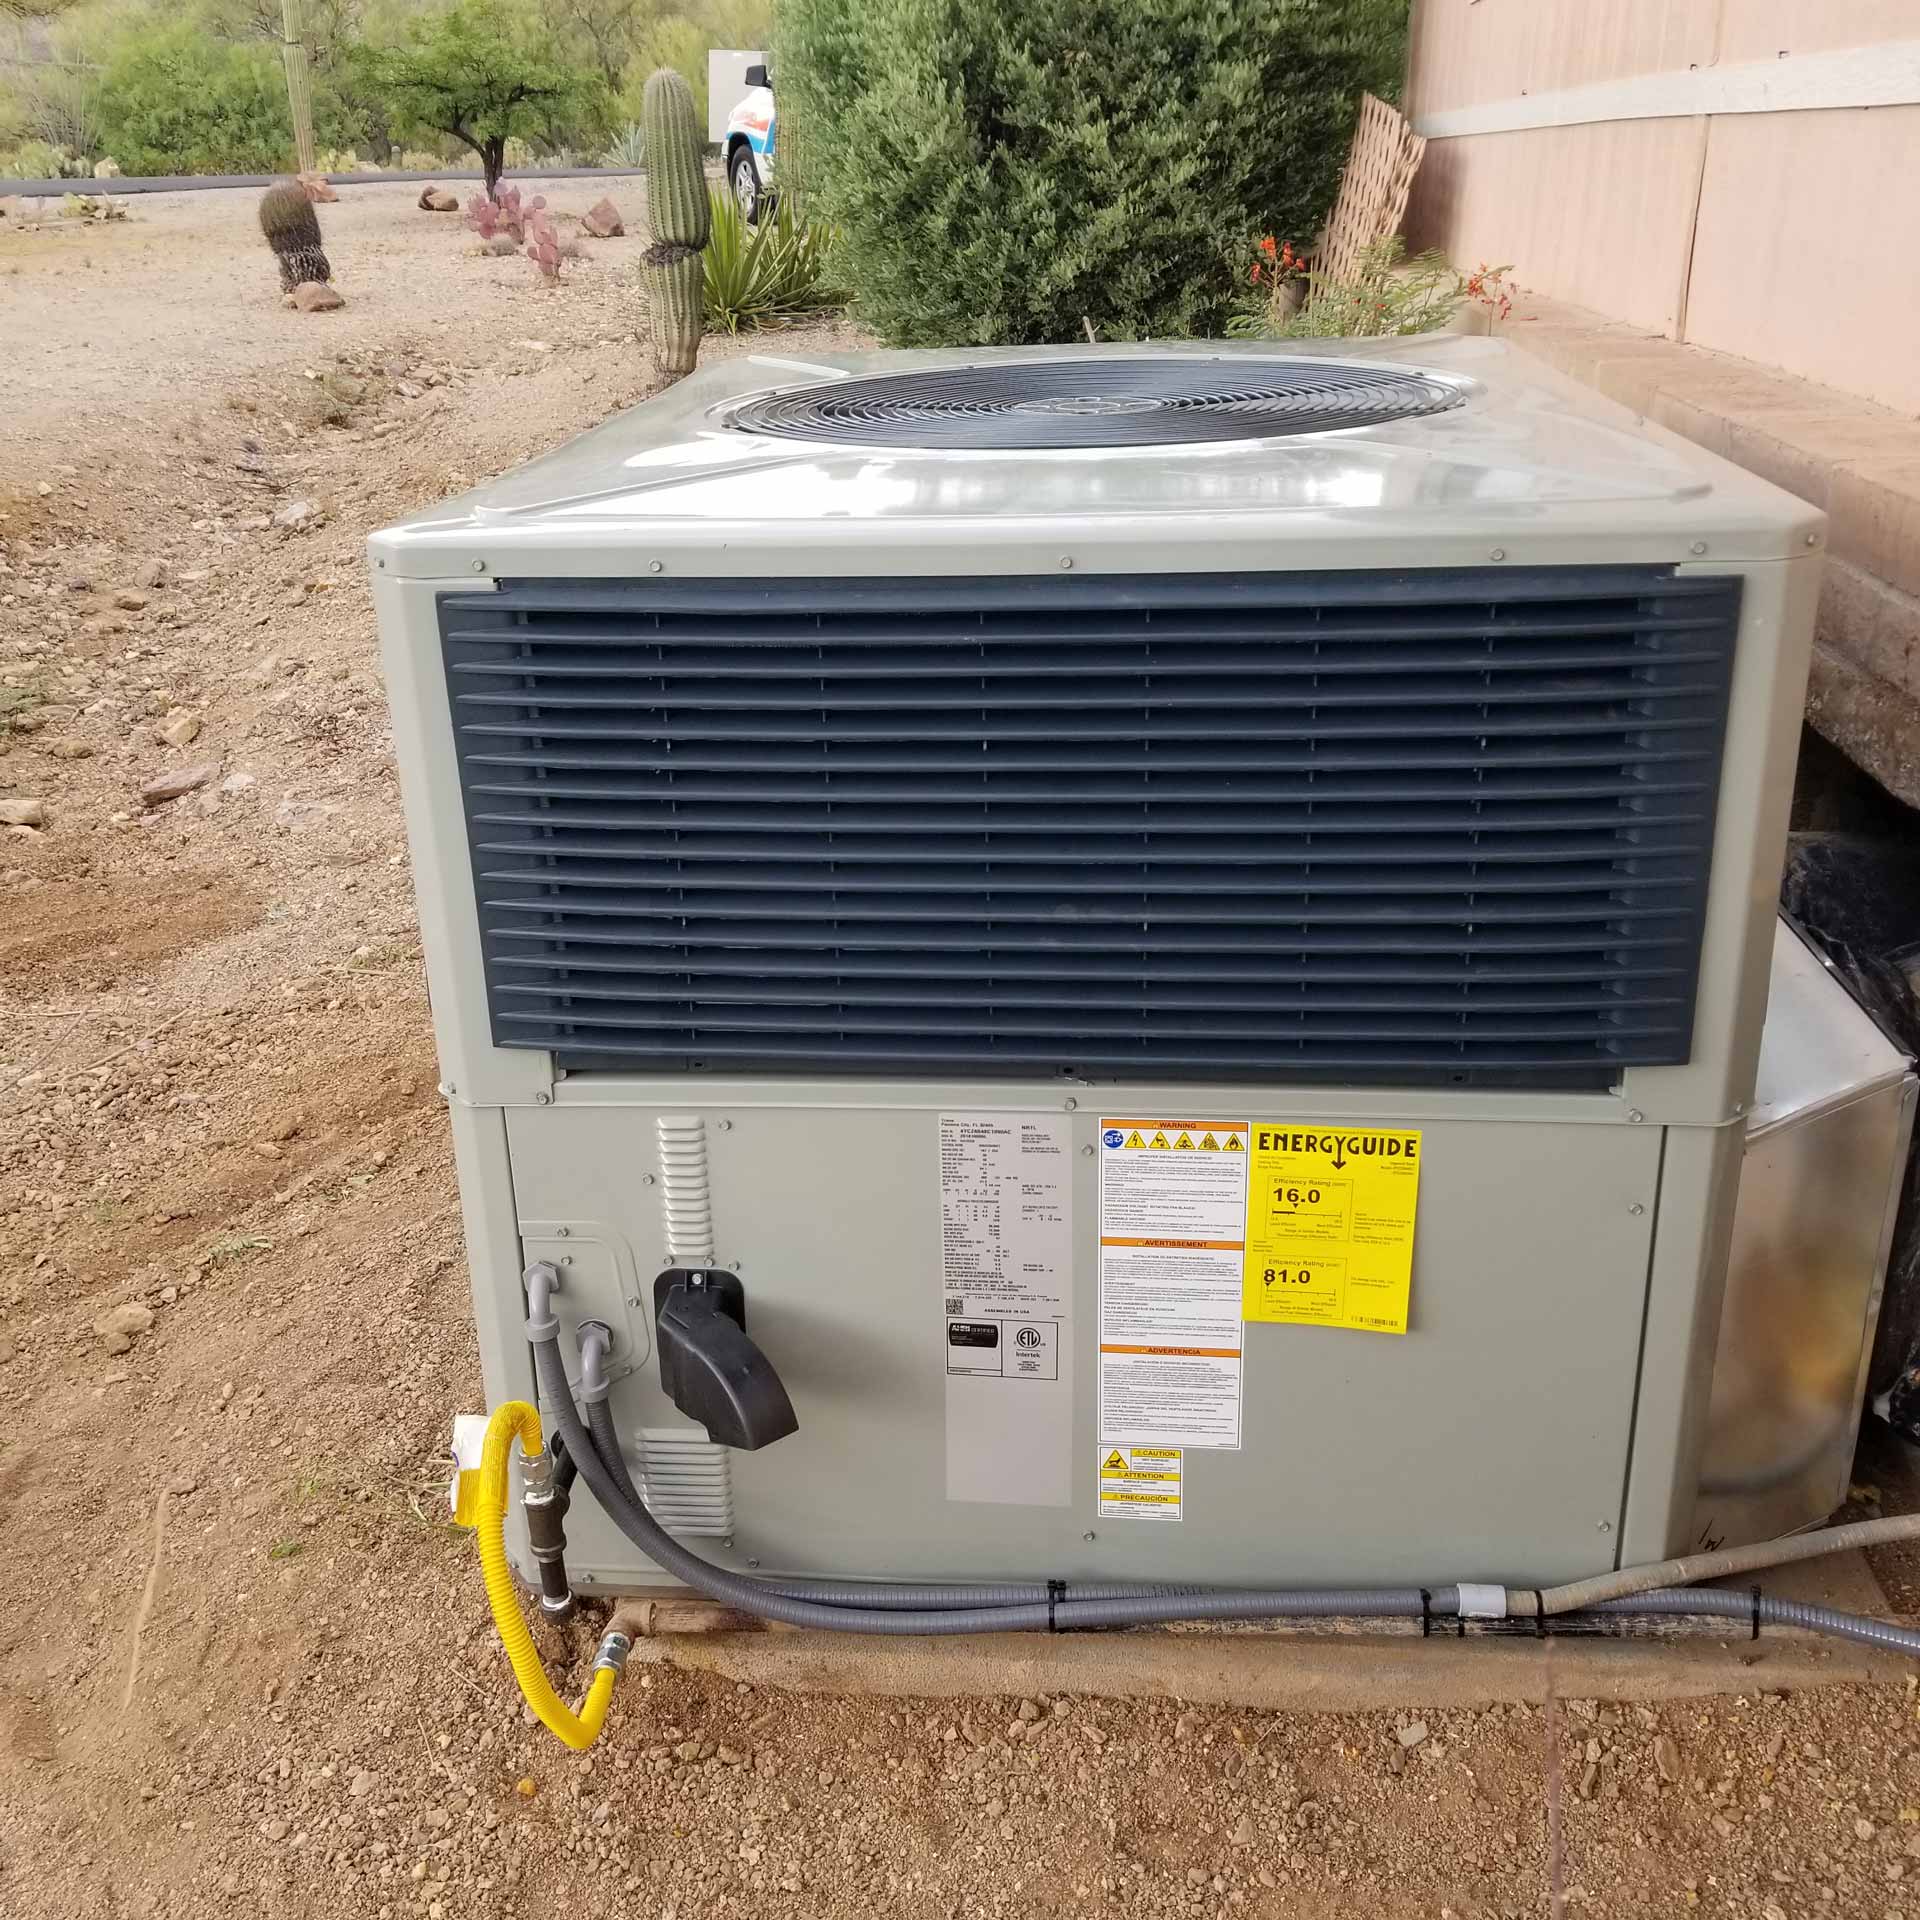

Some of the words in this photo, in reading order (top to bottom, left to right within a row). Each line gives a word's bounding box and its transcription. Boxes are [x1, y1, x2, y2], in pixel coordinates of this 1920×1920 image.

[1258, 1132, 1417, 1161] ENERGYGUIDE
[1273, 1177, 1307, 1186] Efficiency
[1308, 1179, 1331, 1187] Rating
[1273, 1187, 1321, 1203] 16.0
[1144, 1240, 1208, 1248] AVERTISSEMENT
[1302, 1260, 1325, 1268] Rating
[1263, 1268, 1311, 1284] 81.0
[1148, 1347, 1201, 1355] ADVERTENCIA
[1120, 1494, 1168, 1502] PRECAUCIÓN
